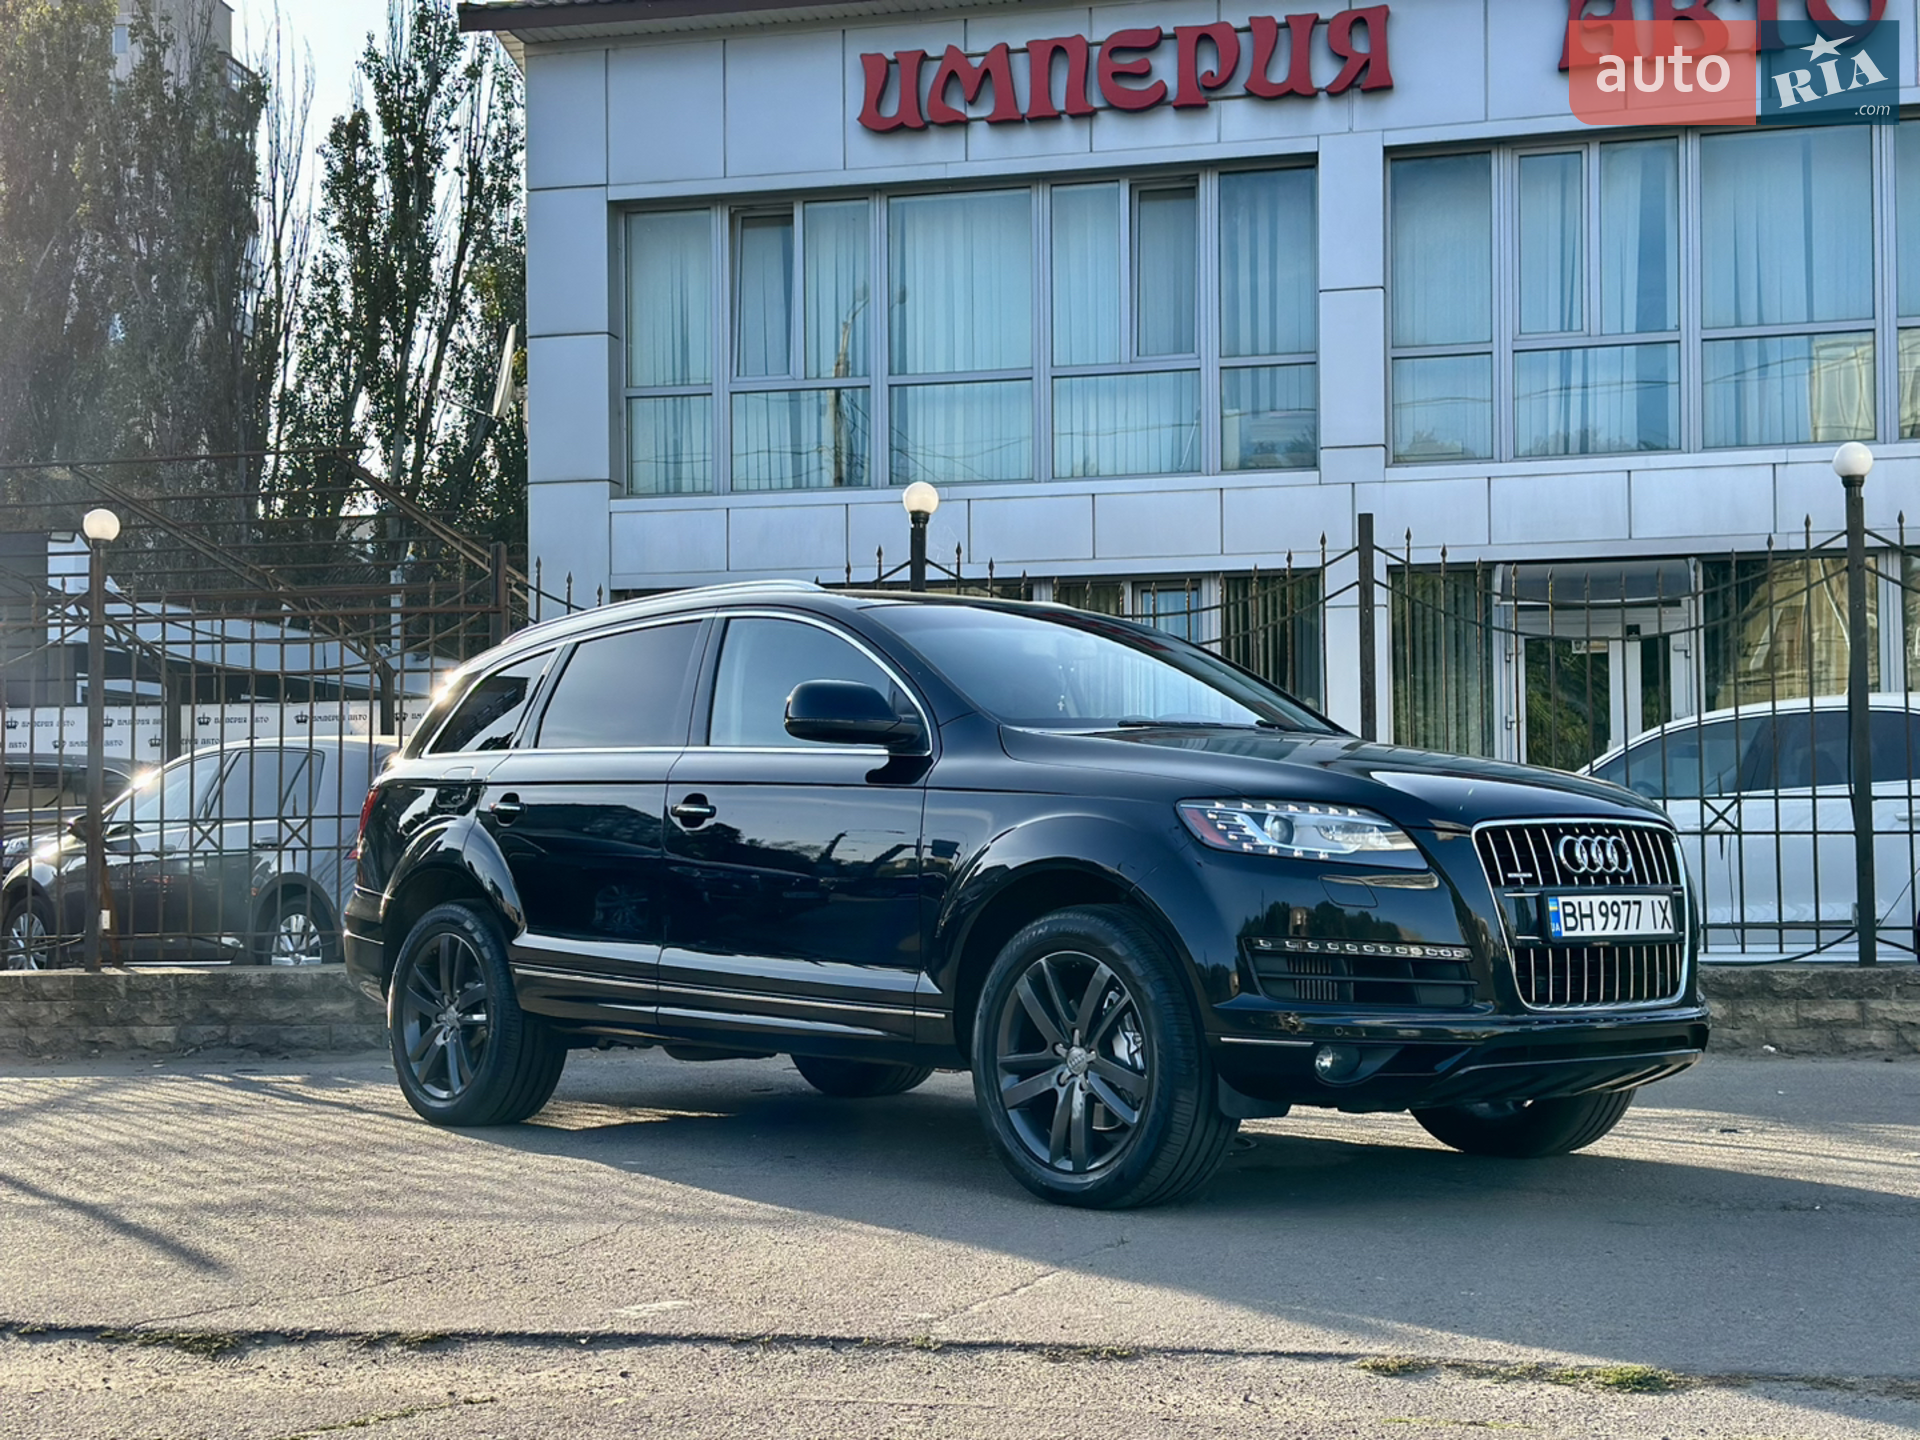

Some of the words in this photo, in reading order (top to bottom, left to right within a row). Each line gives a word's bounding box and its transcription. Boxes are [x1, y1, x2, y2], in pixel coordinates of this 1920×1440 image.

[857, 4, 1394, 132] ИМПЕРИЯ
[1561, 900, 1596, 932] BH
[1598, 900, 1642, 931] 9977
[1650, 899, 1673, 930] IX
